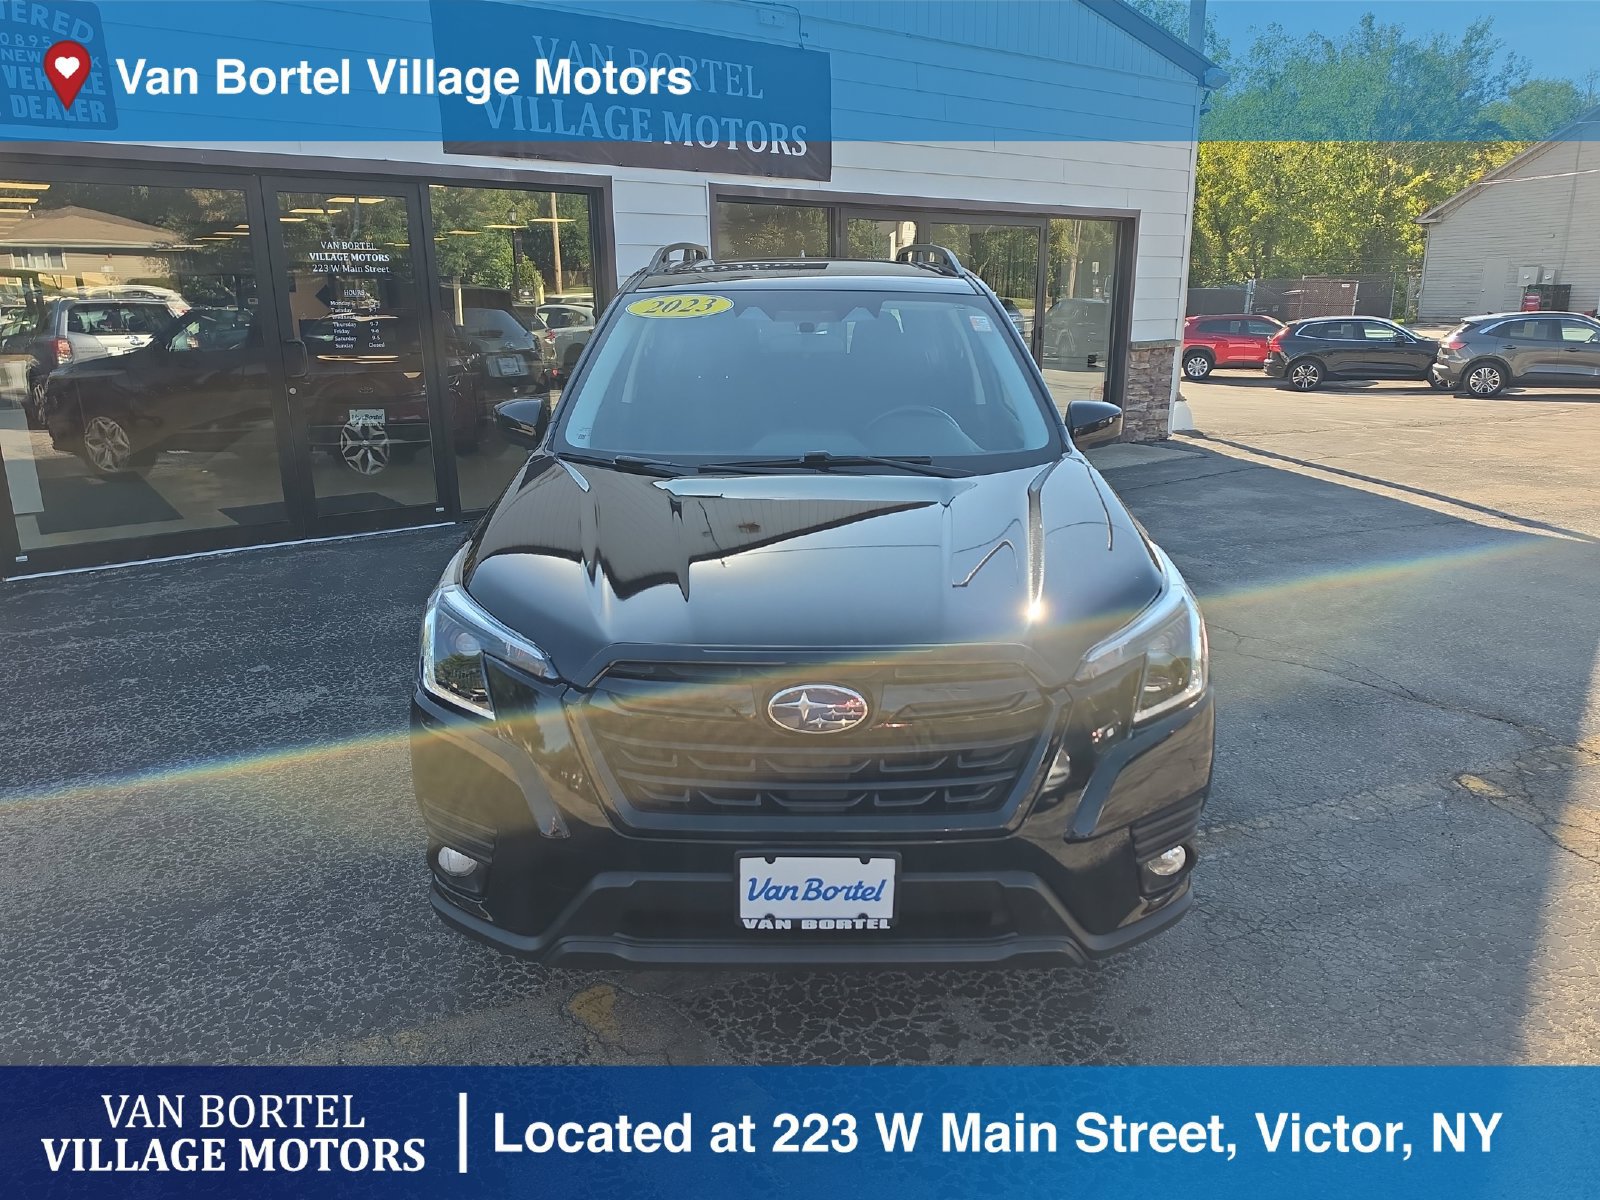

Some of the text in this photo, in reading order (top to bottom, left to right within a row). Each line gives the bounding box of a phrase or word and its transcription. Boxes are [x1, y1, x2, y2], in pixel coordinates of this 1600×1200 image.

[627, 48, 764, 99] BORTEL
[10, 95, 107, 122] DEALER
[484, 92, 807, 156] VILLAGE MOTORS
[320, 241, 377, 250] VAN BORTEL
[309, 252, 390, 262] VILLAGE MOTORS
[312, 264, 390, 273] 223 W Main Street
[343, 289, 365, 297] HOURS
[642, 298, 717, 314] 2023
[747, 877, 888, 902] Van Bortel
[741, 918, 891, 930] VAN BORTEL
